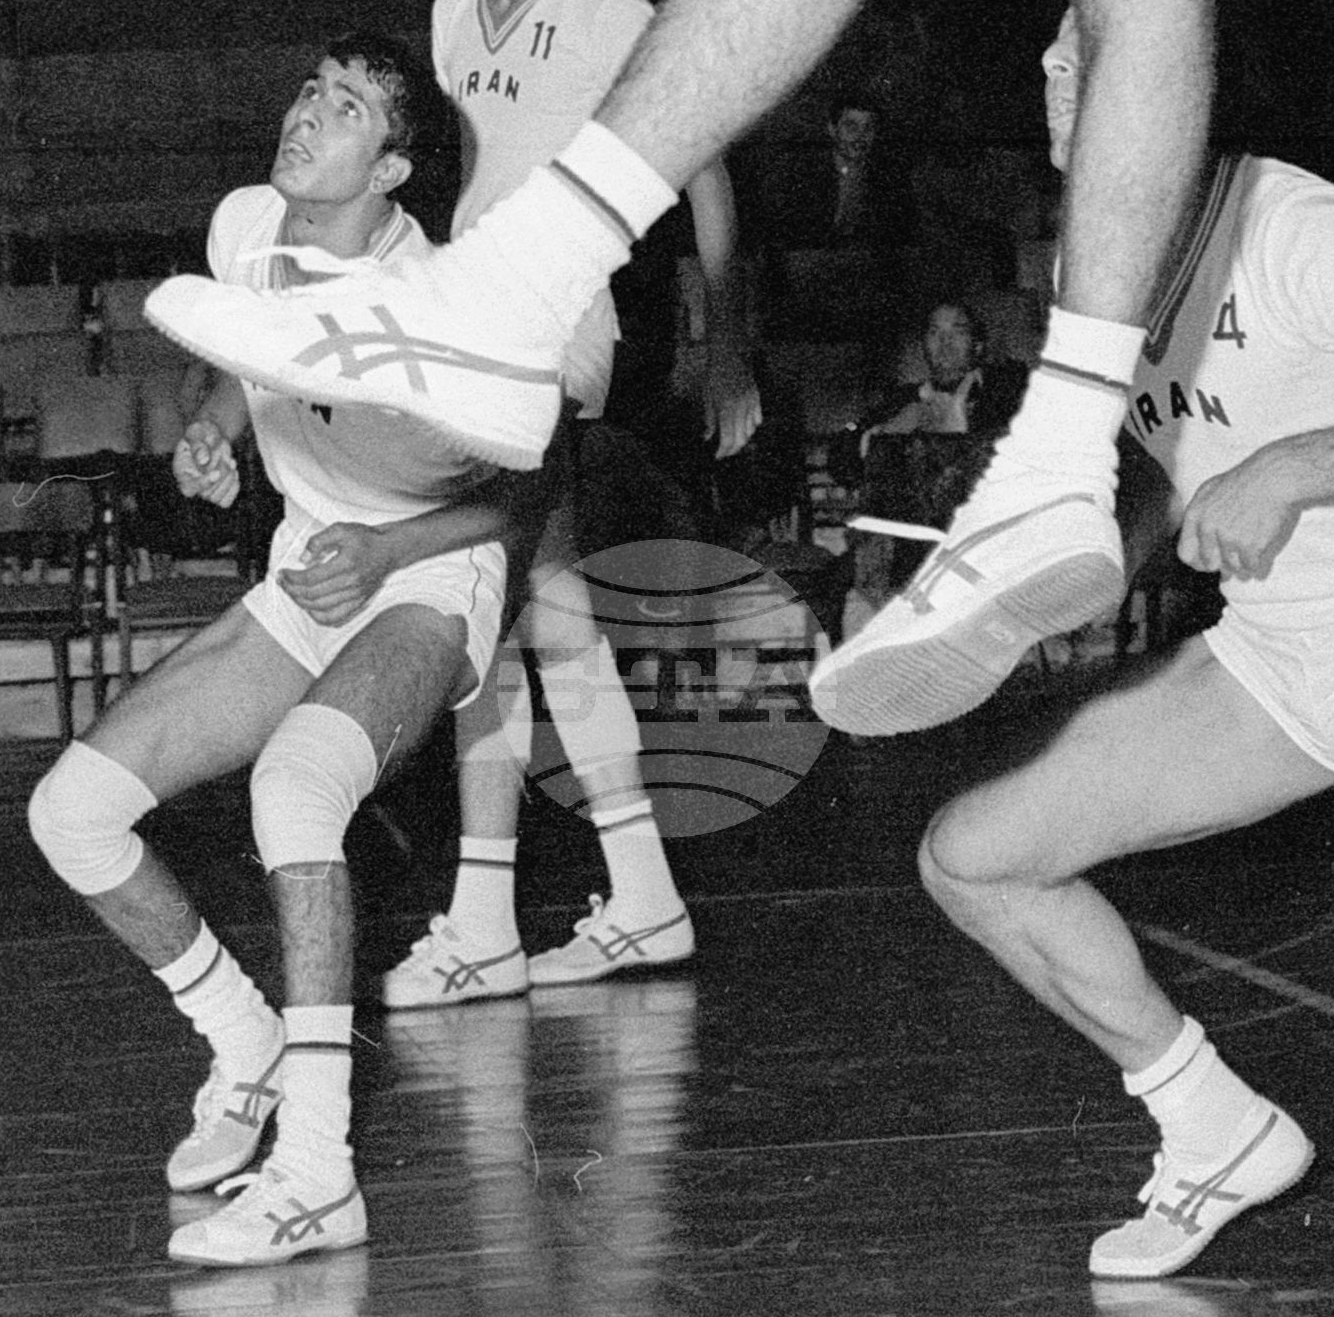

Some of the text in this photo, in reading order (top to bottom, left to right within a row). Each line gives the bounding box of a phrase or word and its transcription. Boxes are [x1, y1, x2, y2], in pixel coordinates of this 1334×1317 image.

[530, 20, 556, 60] 11
[458, 69, 520, 103] IRAN
[1212, 293, 1247, 349] 4
[1129, 381, 1231, 442] IRAN
